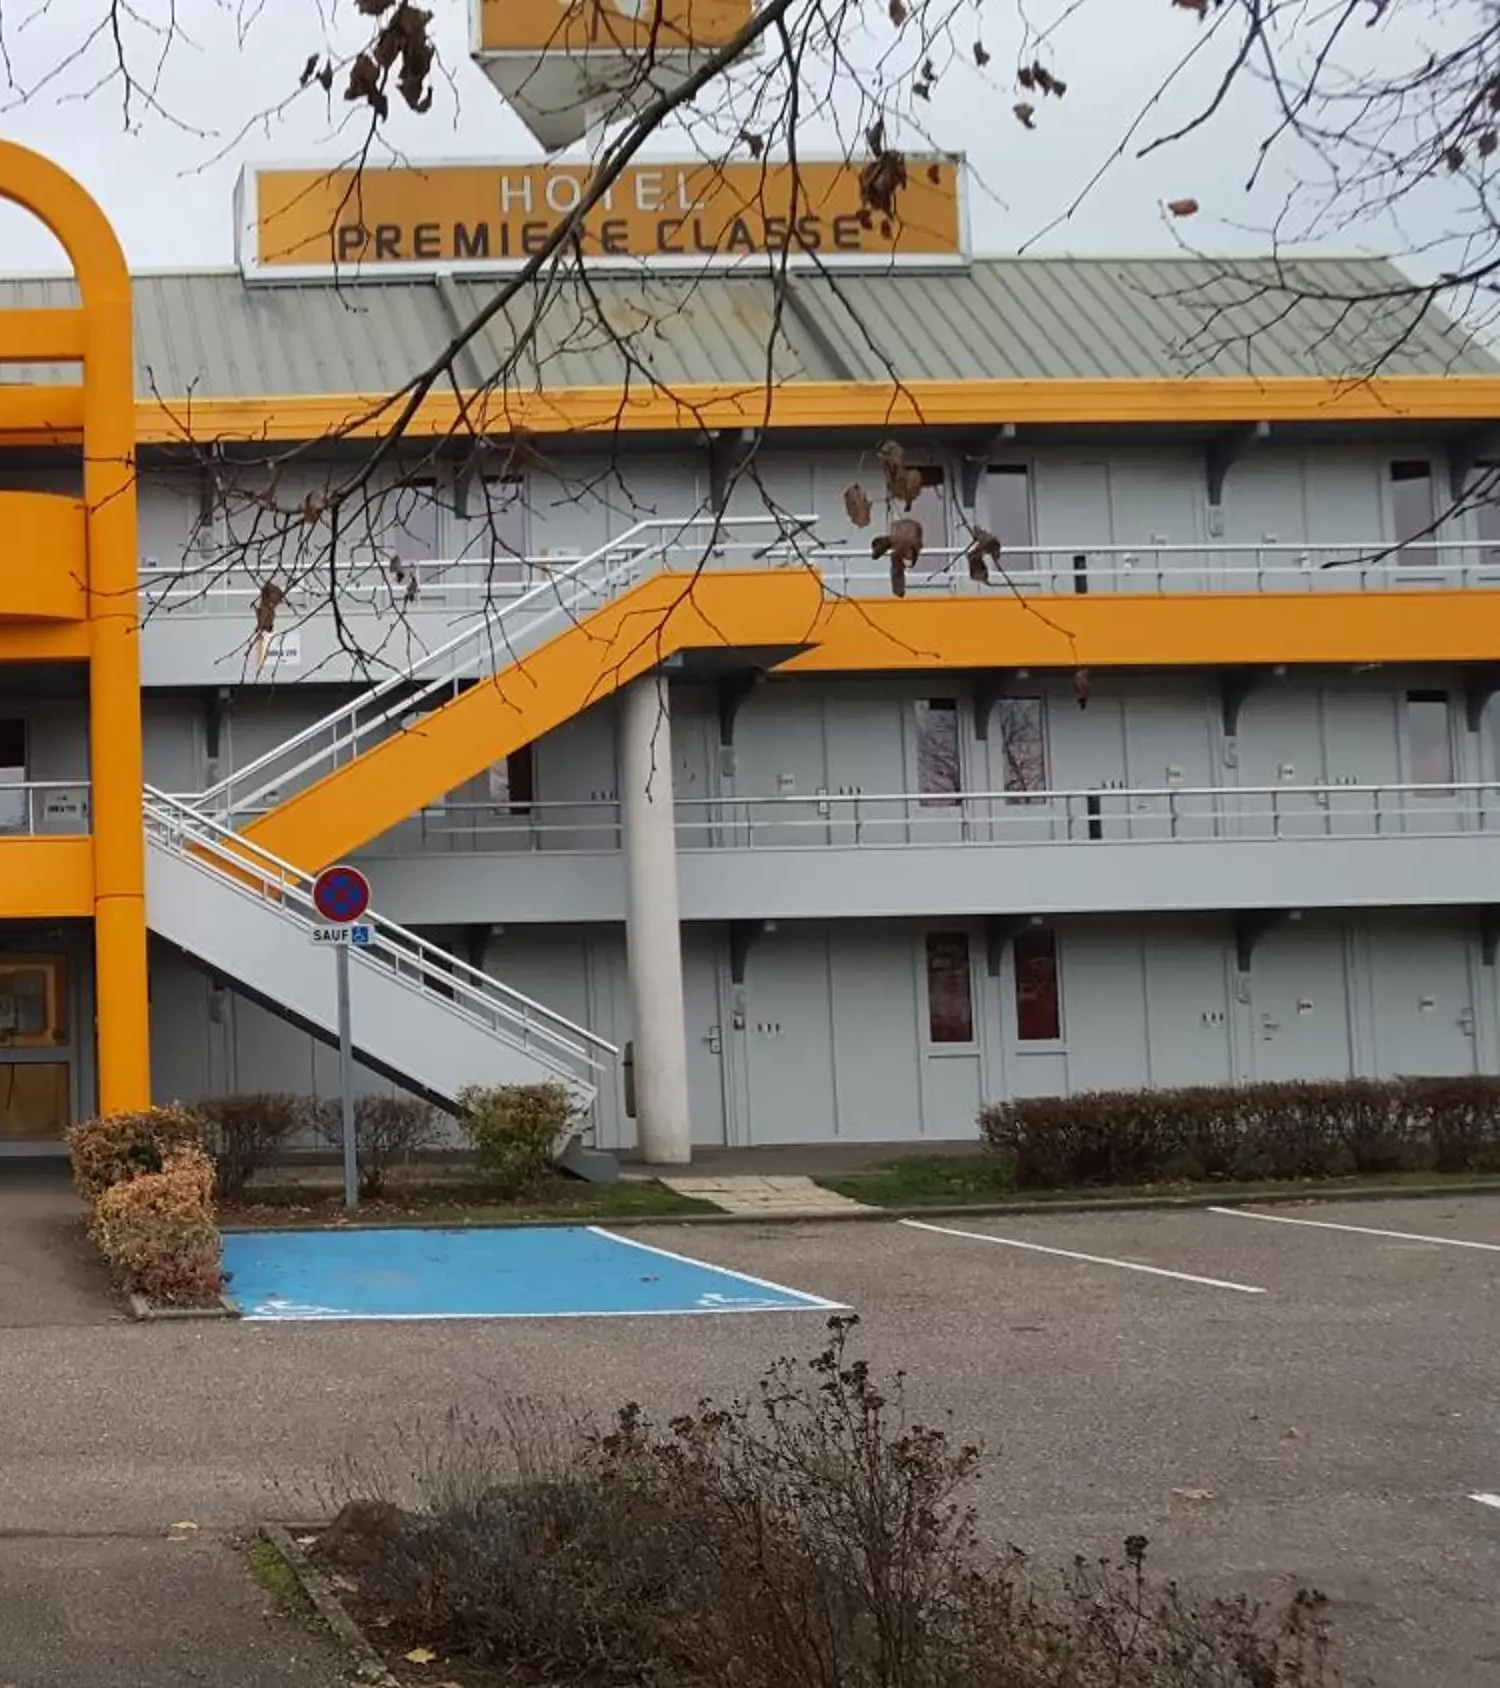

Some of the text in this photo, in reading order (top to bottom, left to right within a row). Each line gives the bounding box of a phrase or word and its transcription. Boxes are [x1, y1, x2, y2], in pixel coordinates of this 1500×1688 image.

[337, 215, 862, 260] PREMIEE CLASSE
[313, 928, 349, 942] SAUF
